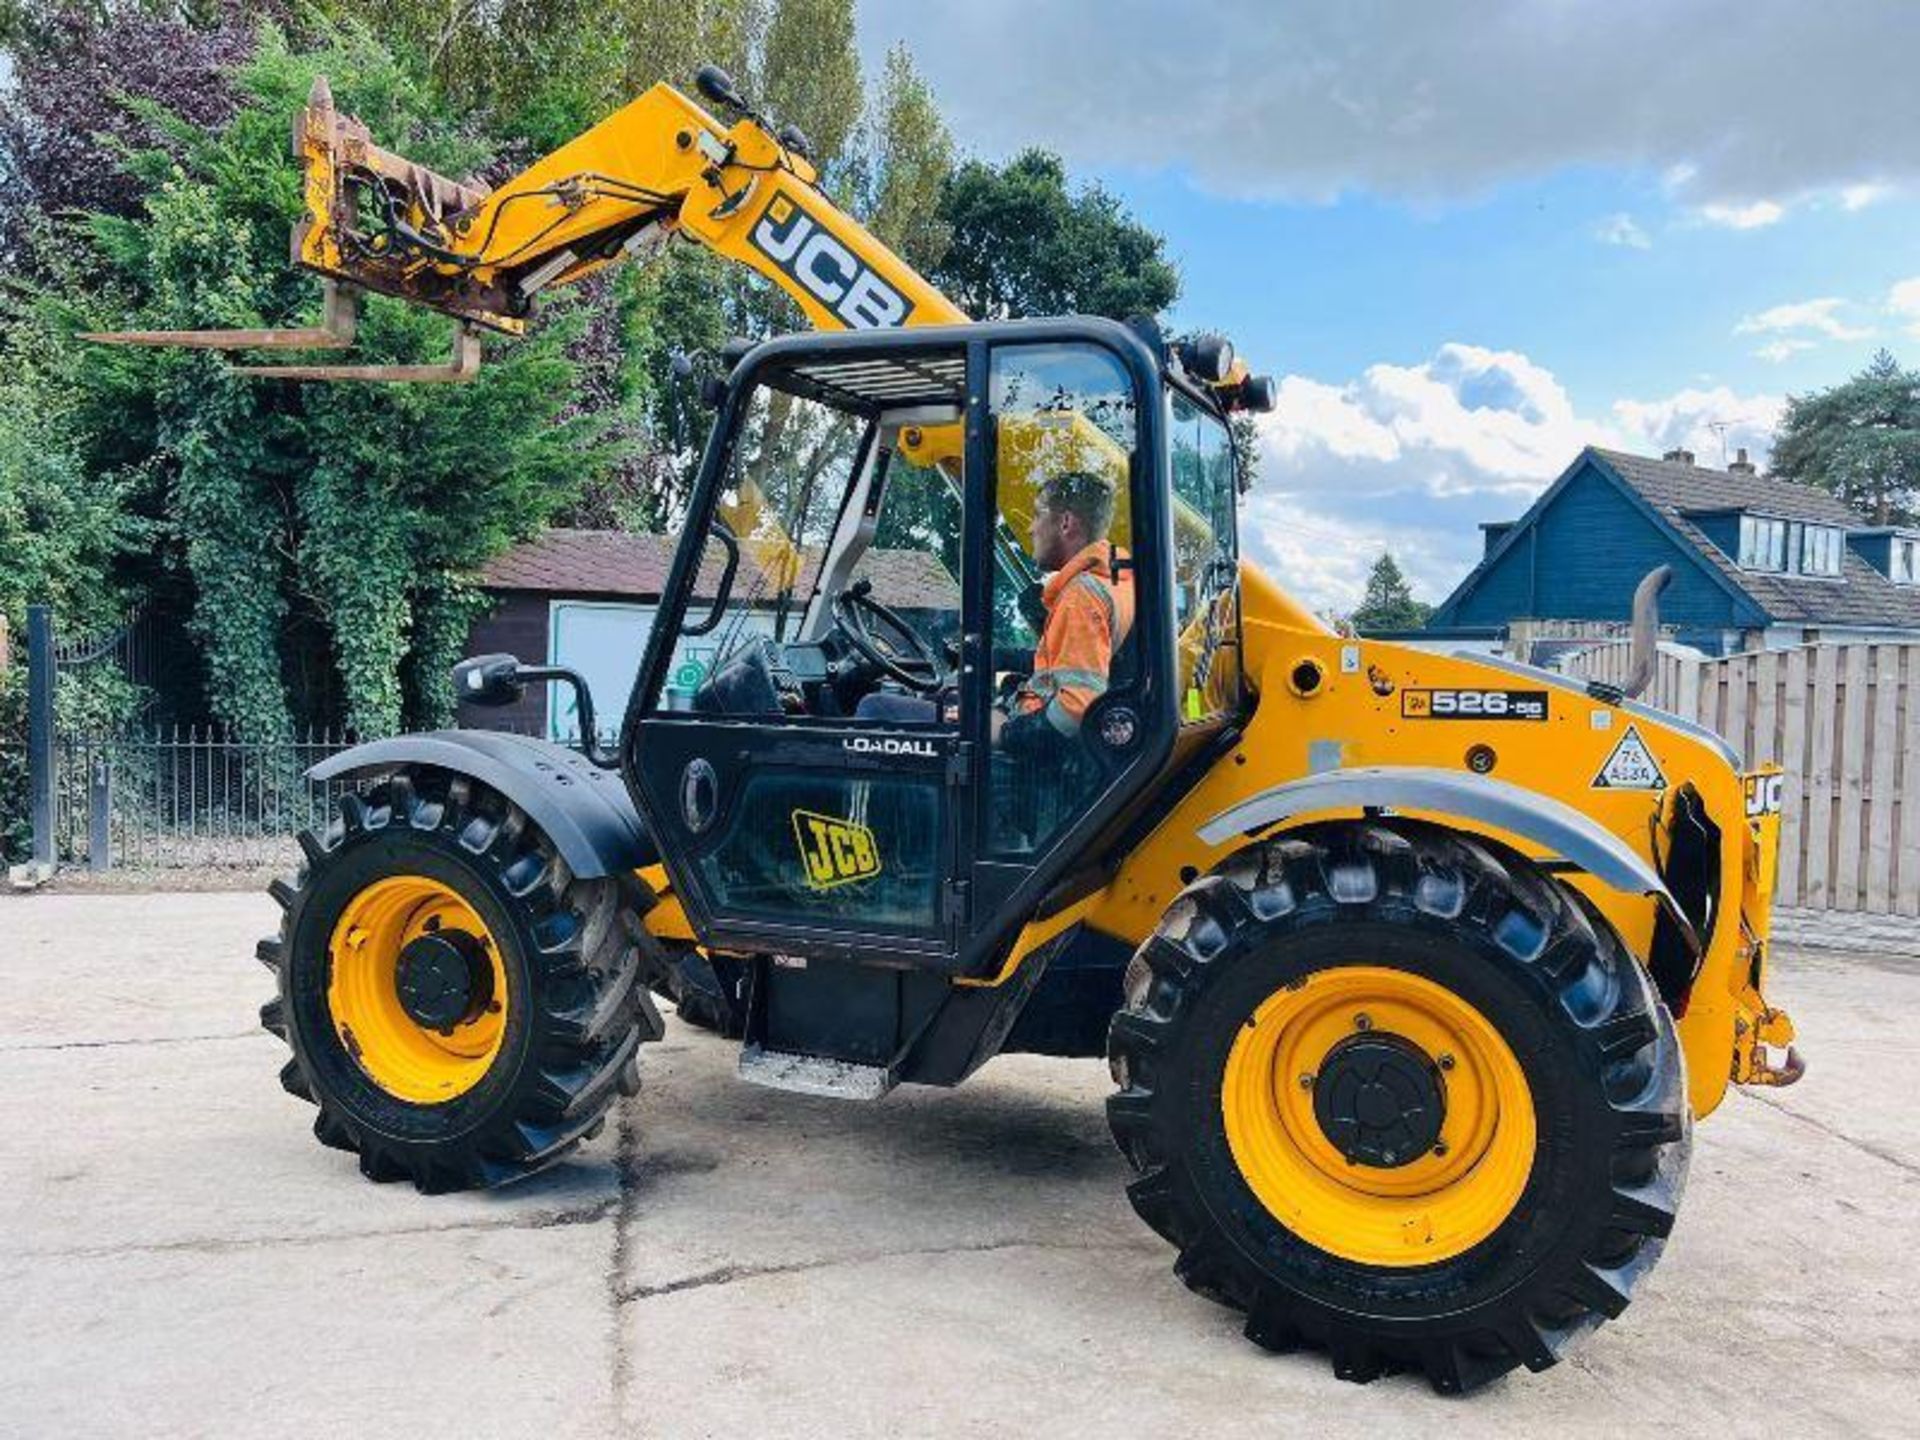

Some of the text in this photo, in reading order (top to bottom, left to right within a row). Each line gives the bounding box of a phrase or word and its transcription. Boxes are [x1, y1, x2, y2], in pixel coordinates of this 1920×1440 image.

[755, 213, 905, 329] JCB
[842, 738, 938, 757] LOADALL
[808, 818, 875, 881] JCB
